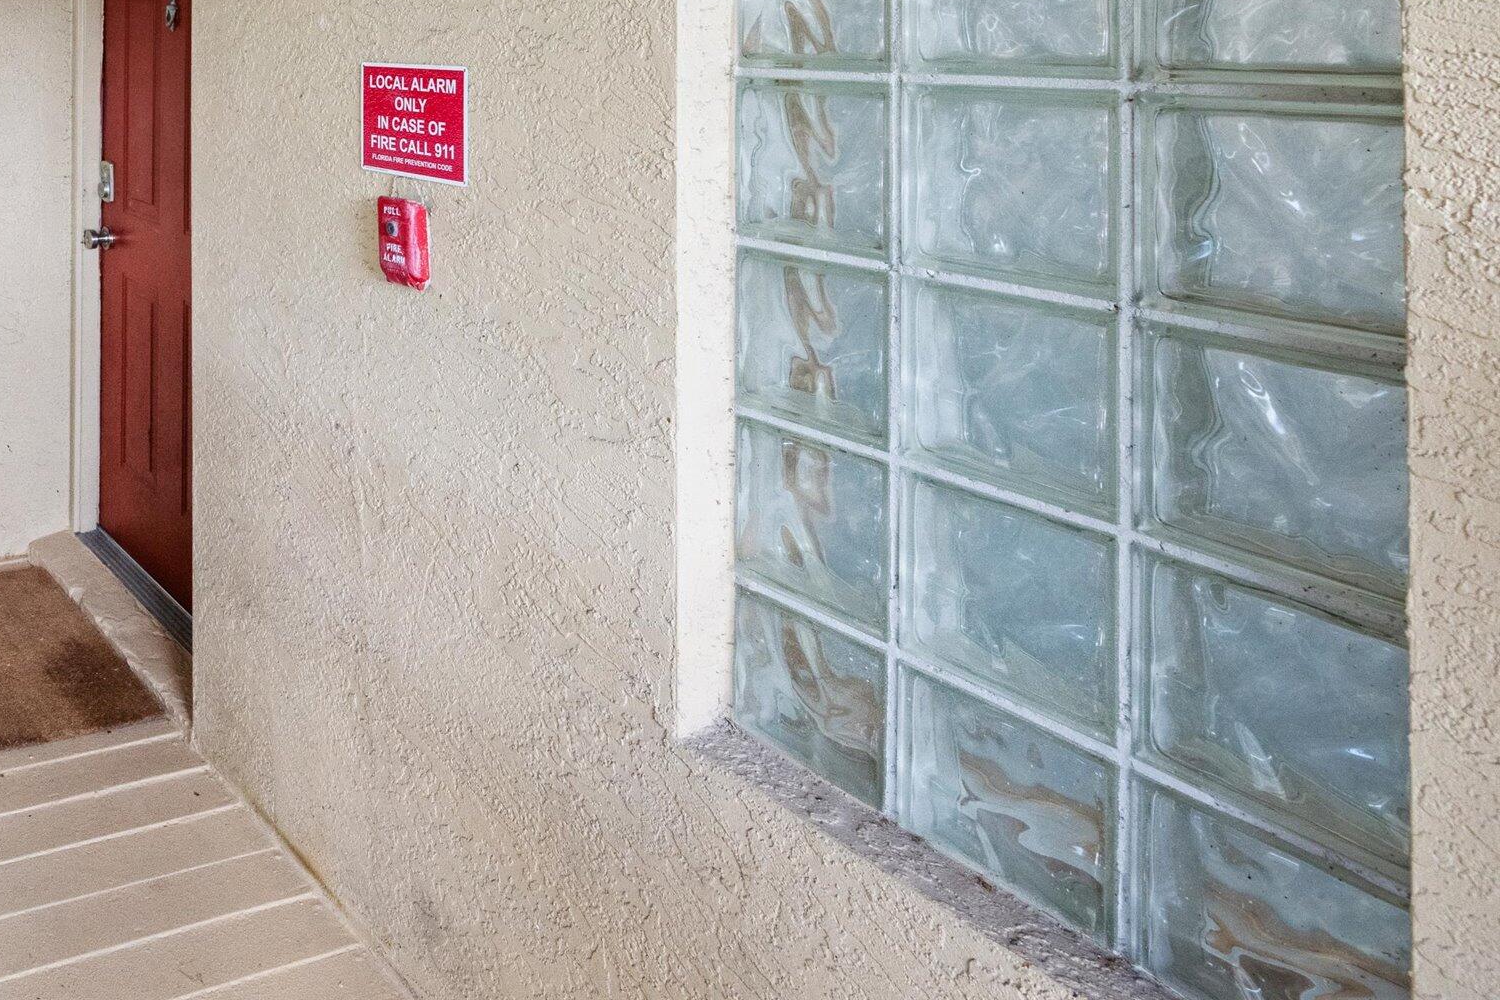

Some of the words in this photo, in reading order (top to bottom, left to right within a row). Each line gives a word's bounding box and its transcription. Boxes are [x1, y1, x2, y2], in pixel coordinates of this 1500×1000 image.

[369, 74, 408, 91] LOCAL
[411, 77, 457, 94] ALARM
[394, 96, 427, 113] ONLY
[377, 115, 389, 129] IN
[392, 117, 425, 134] CASE
[428, 121, 446, 136] OF
[370, 134, 396, 151] FIRE
[399, 138, 432, 156] CALL
[435, 143, 455, 160] 911
[372, 153, 392, 162] FLORIDA
[404, 158, 437, 170] PREVENTION
[437, 163, 453, 172] CODE
[383, 206, 401, 216] PULL
[386, 243, 402, 253] FIRE
[383, 253, 405, 264] ALARM
